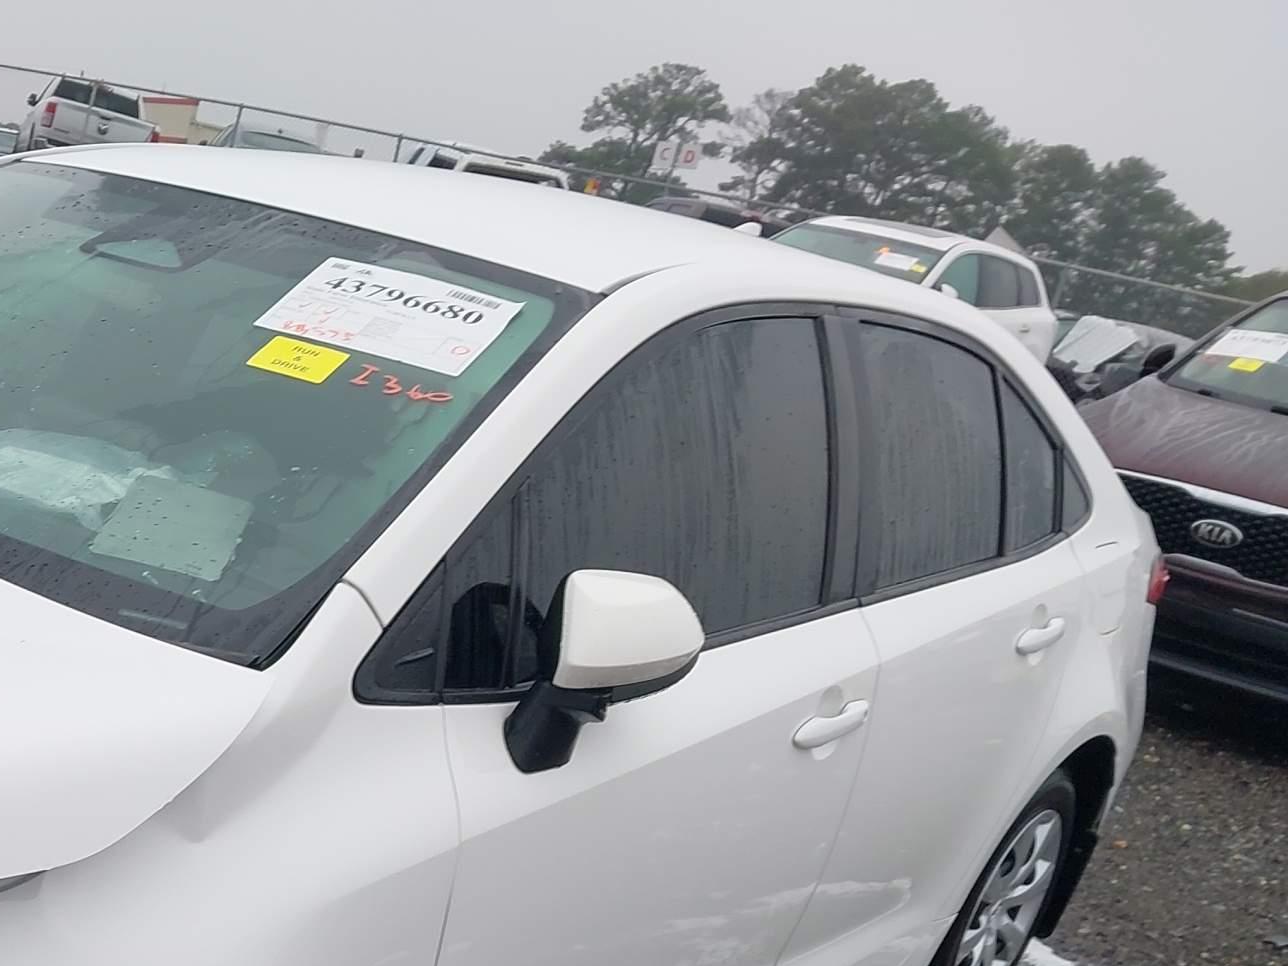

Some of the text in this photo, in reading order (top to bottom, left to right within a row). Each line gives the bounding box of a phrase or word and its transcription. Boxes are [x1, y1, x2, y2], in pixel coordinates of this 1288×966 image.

[324, 276, 485, 325] 43796680
[291, 345, 321, 357] RUN
[271, 358, 311, 372] DRIVE
[1197, 523, 1232, 545] KIA
